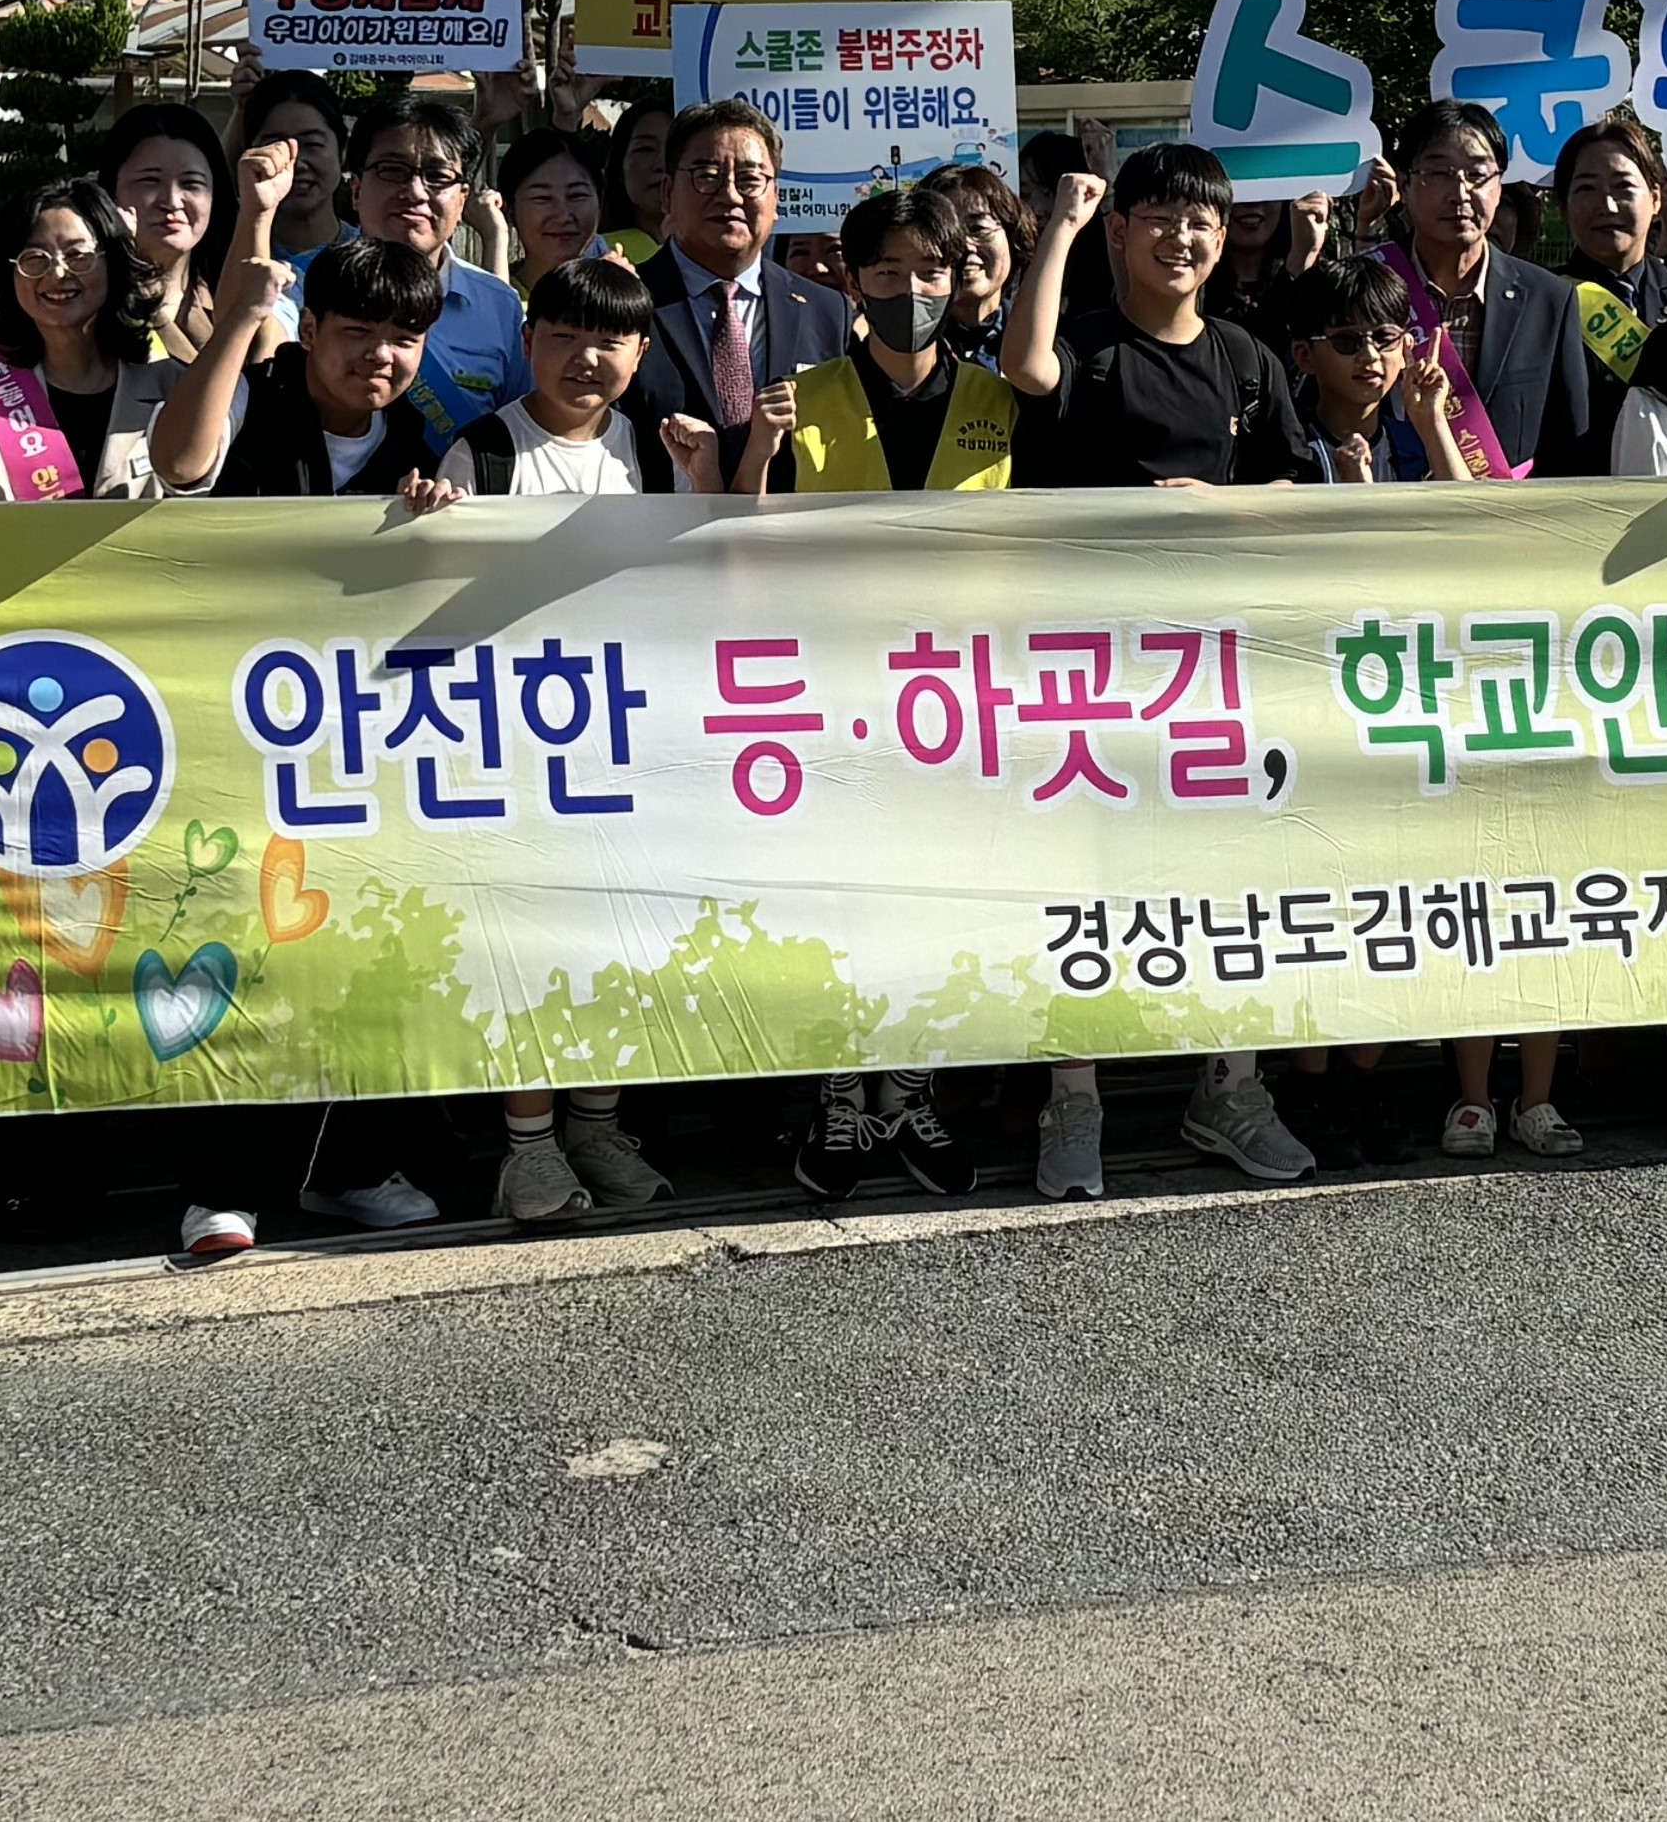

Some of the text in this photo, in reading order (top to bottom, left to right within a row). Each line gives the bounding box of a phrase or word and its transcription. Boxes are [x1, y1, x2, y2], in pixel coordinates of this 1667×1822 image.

[735, 27, 984, 71] 스쿨존 불법주정차
[864, 86, 989, 128] 위험해요.
[245, 637, 647, 827] 안전한
